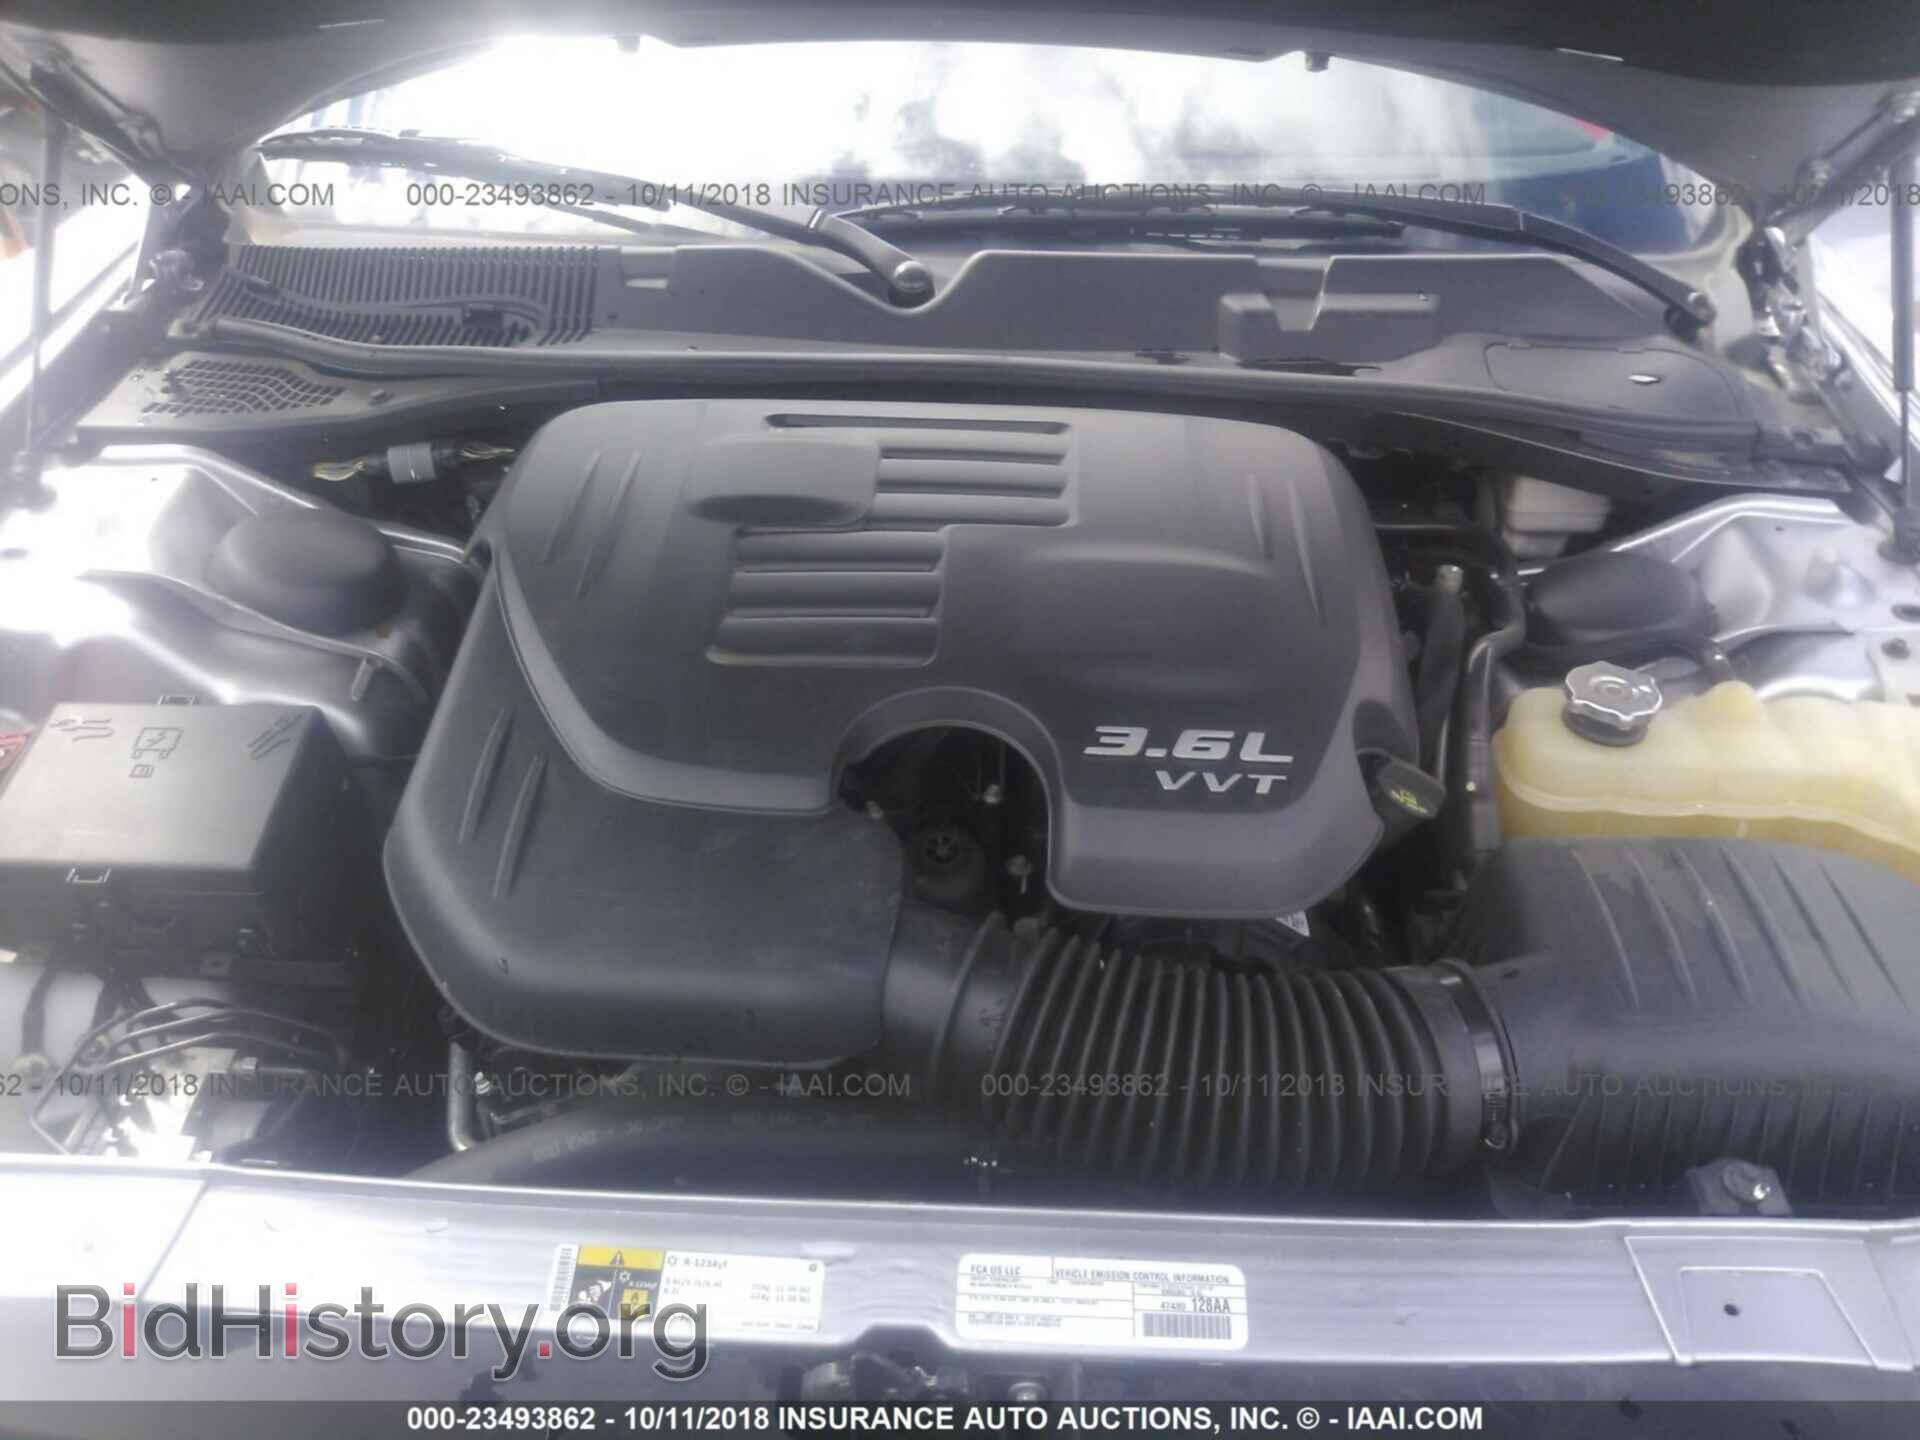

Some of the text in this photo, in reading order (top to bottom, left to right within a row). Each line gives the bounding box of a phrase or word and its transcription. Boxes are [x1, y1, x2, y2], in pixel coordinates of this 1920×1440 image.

[1083, 726, 1294, 763] 3.6L
[1155, 770, 1287, 794] VVT
[970, 1264, 988, 1275] FCA
[1005, 1266, 1021, 1276] LLC
[1192, 1297, 1231, 1313] 128AA
